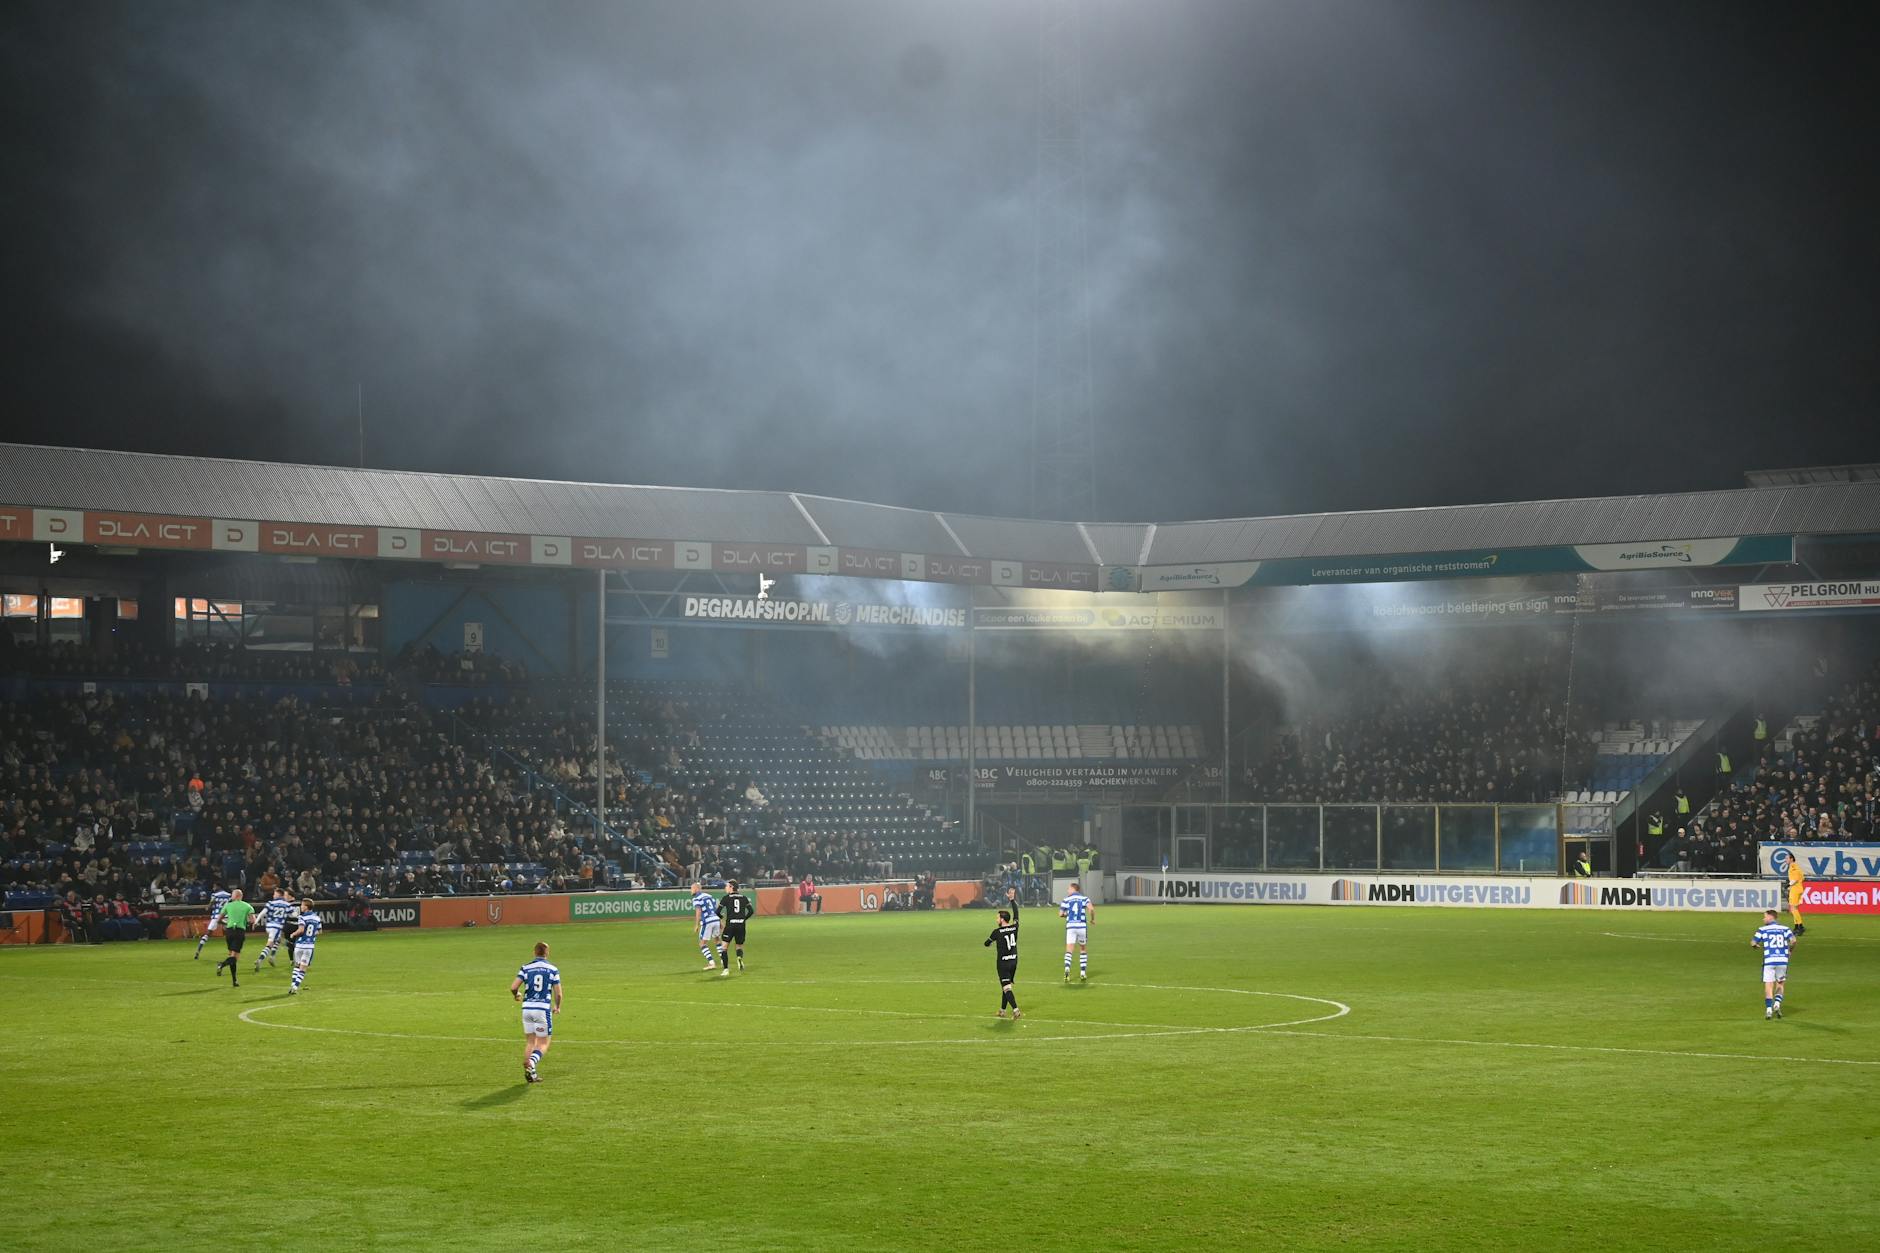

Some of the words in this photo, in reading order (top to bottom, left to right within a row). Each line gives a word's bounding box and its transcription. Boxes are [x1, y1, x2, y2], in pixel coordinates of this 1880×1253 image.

[99, 520, 150, 537] DLA
[159, 525, 197, 541] ICT
[273, 530, 320, 546] DLA
[329, 533, 364, 548] ICT
[434, 538, 479, 553] DLA
[486, 541, 518, 555] ICT
[584, 545, 625, 560] DLA
[632, 547, 663, 561] ICT
[723, 550, 761, 564] DLA
[767, 552, 796, 566] ICT
[1619, 550, 1684, 561] AgriBioSource
[845, 554, 871, 569] DLA
[875, 557, 895, 570] ICT
[931, 562, 954, 576] DLA
[958, 564, 983, 577] ICT
[1312, 567, 1361, 577] Leverancier
[1365, 567, 1381, 575] van
[1383, 563, 1432, 576] organische
[1435, 561, 1490, 572] reststromen
[1029, 569, 1061, 582] DLA
[1066, 571, 1091, 584] ICT
[1791, 583, 1861, 597] PELGROM
[685, 597, 830, 622] DEGRAAFSHOP.NL
[856, 604, 966, 627] MERCHANDISE
[1447, 600, 1506, 615] belettering
[1509, 601, 1523, 611] en
[1526, 598, 1548, 613] sign
[1129, 615, 1215, 626] ACTEMIUM
[929, 769, 947, 780] ABC
[1065, 768, 1114, 776] VERTAALD
[1118, 768, 1128, 776] IN
[1799, 886, 1868, 906] Keuken
[575, 900, 641, 915] BEZORGING
[643, 900, 651, 912] &
[653, 898, 693, 912] SERVIC
[706, 899, 714, 909] 3
[733, 899, 741, 913] 9
[1072, 902, 1079, 915] 4
[273, 907, 285, 918] 23
[306, 924, 314, 937] 8
[1005, 932, 1017, 950] 14
[1768, 934, 1785, 949] 28
[534, 974, 544, 992] 9
